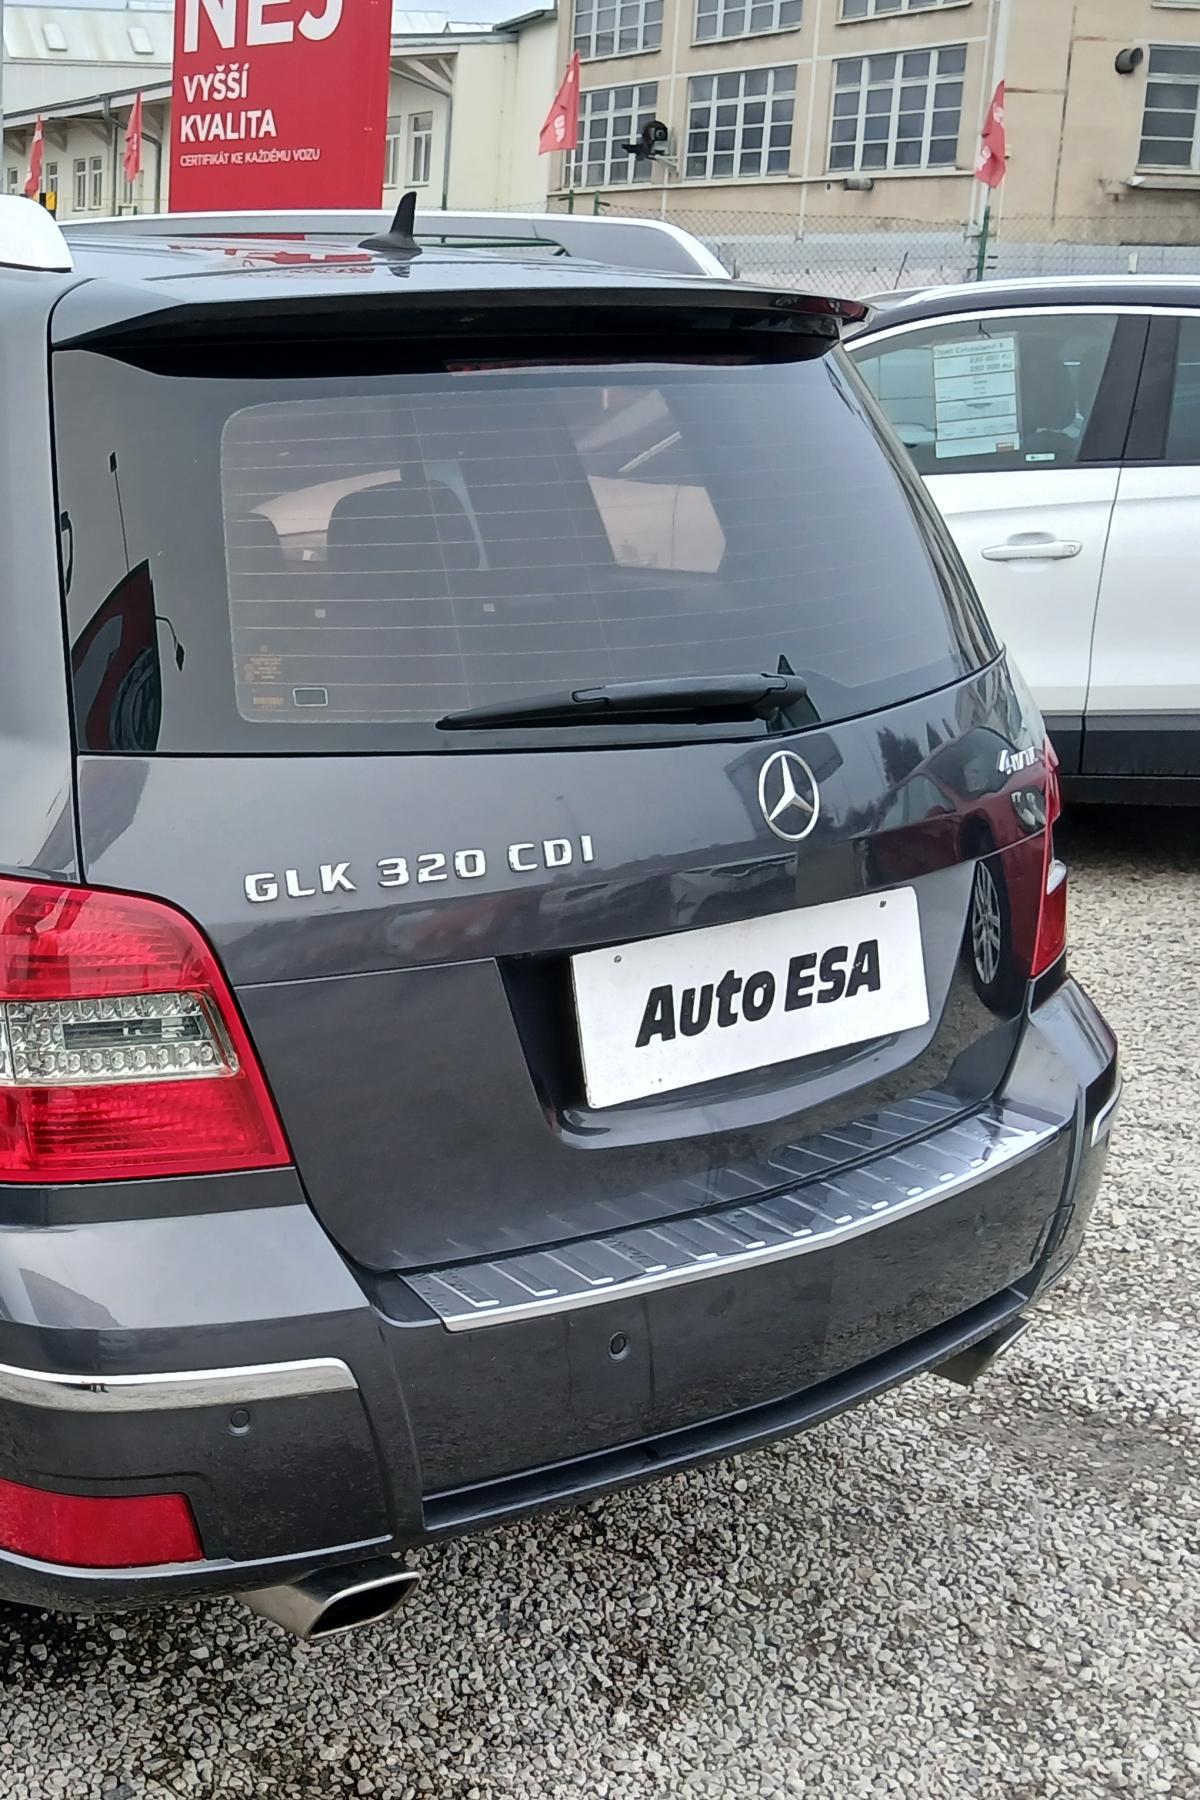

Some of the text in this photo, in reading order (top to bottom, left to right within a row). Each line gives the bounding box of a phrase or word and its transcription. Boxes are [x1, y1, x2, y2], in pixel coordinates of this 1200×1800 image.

[183, 62, 249, 102] VYŠŠÍ
[180, 109, 277, 143] KVALITA
[180, 151, 230, 167] CERTIFIKÁT
[231, 152, 243, 164] KE
[293, 148, 320, 161] VOZU
[244, 834, 594, 903] GLK 320 CDI
[635, 938, 882, 1048] Auto ESA
